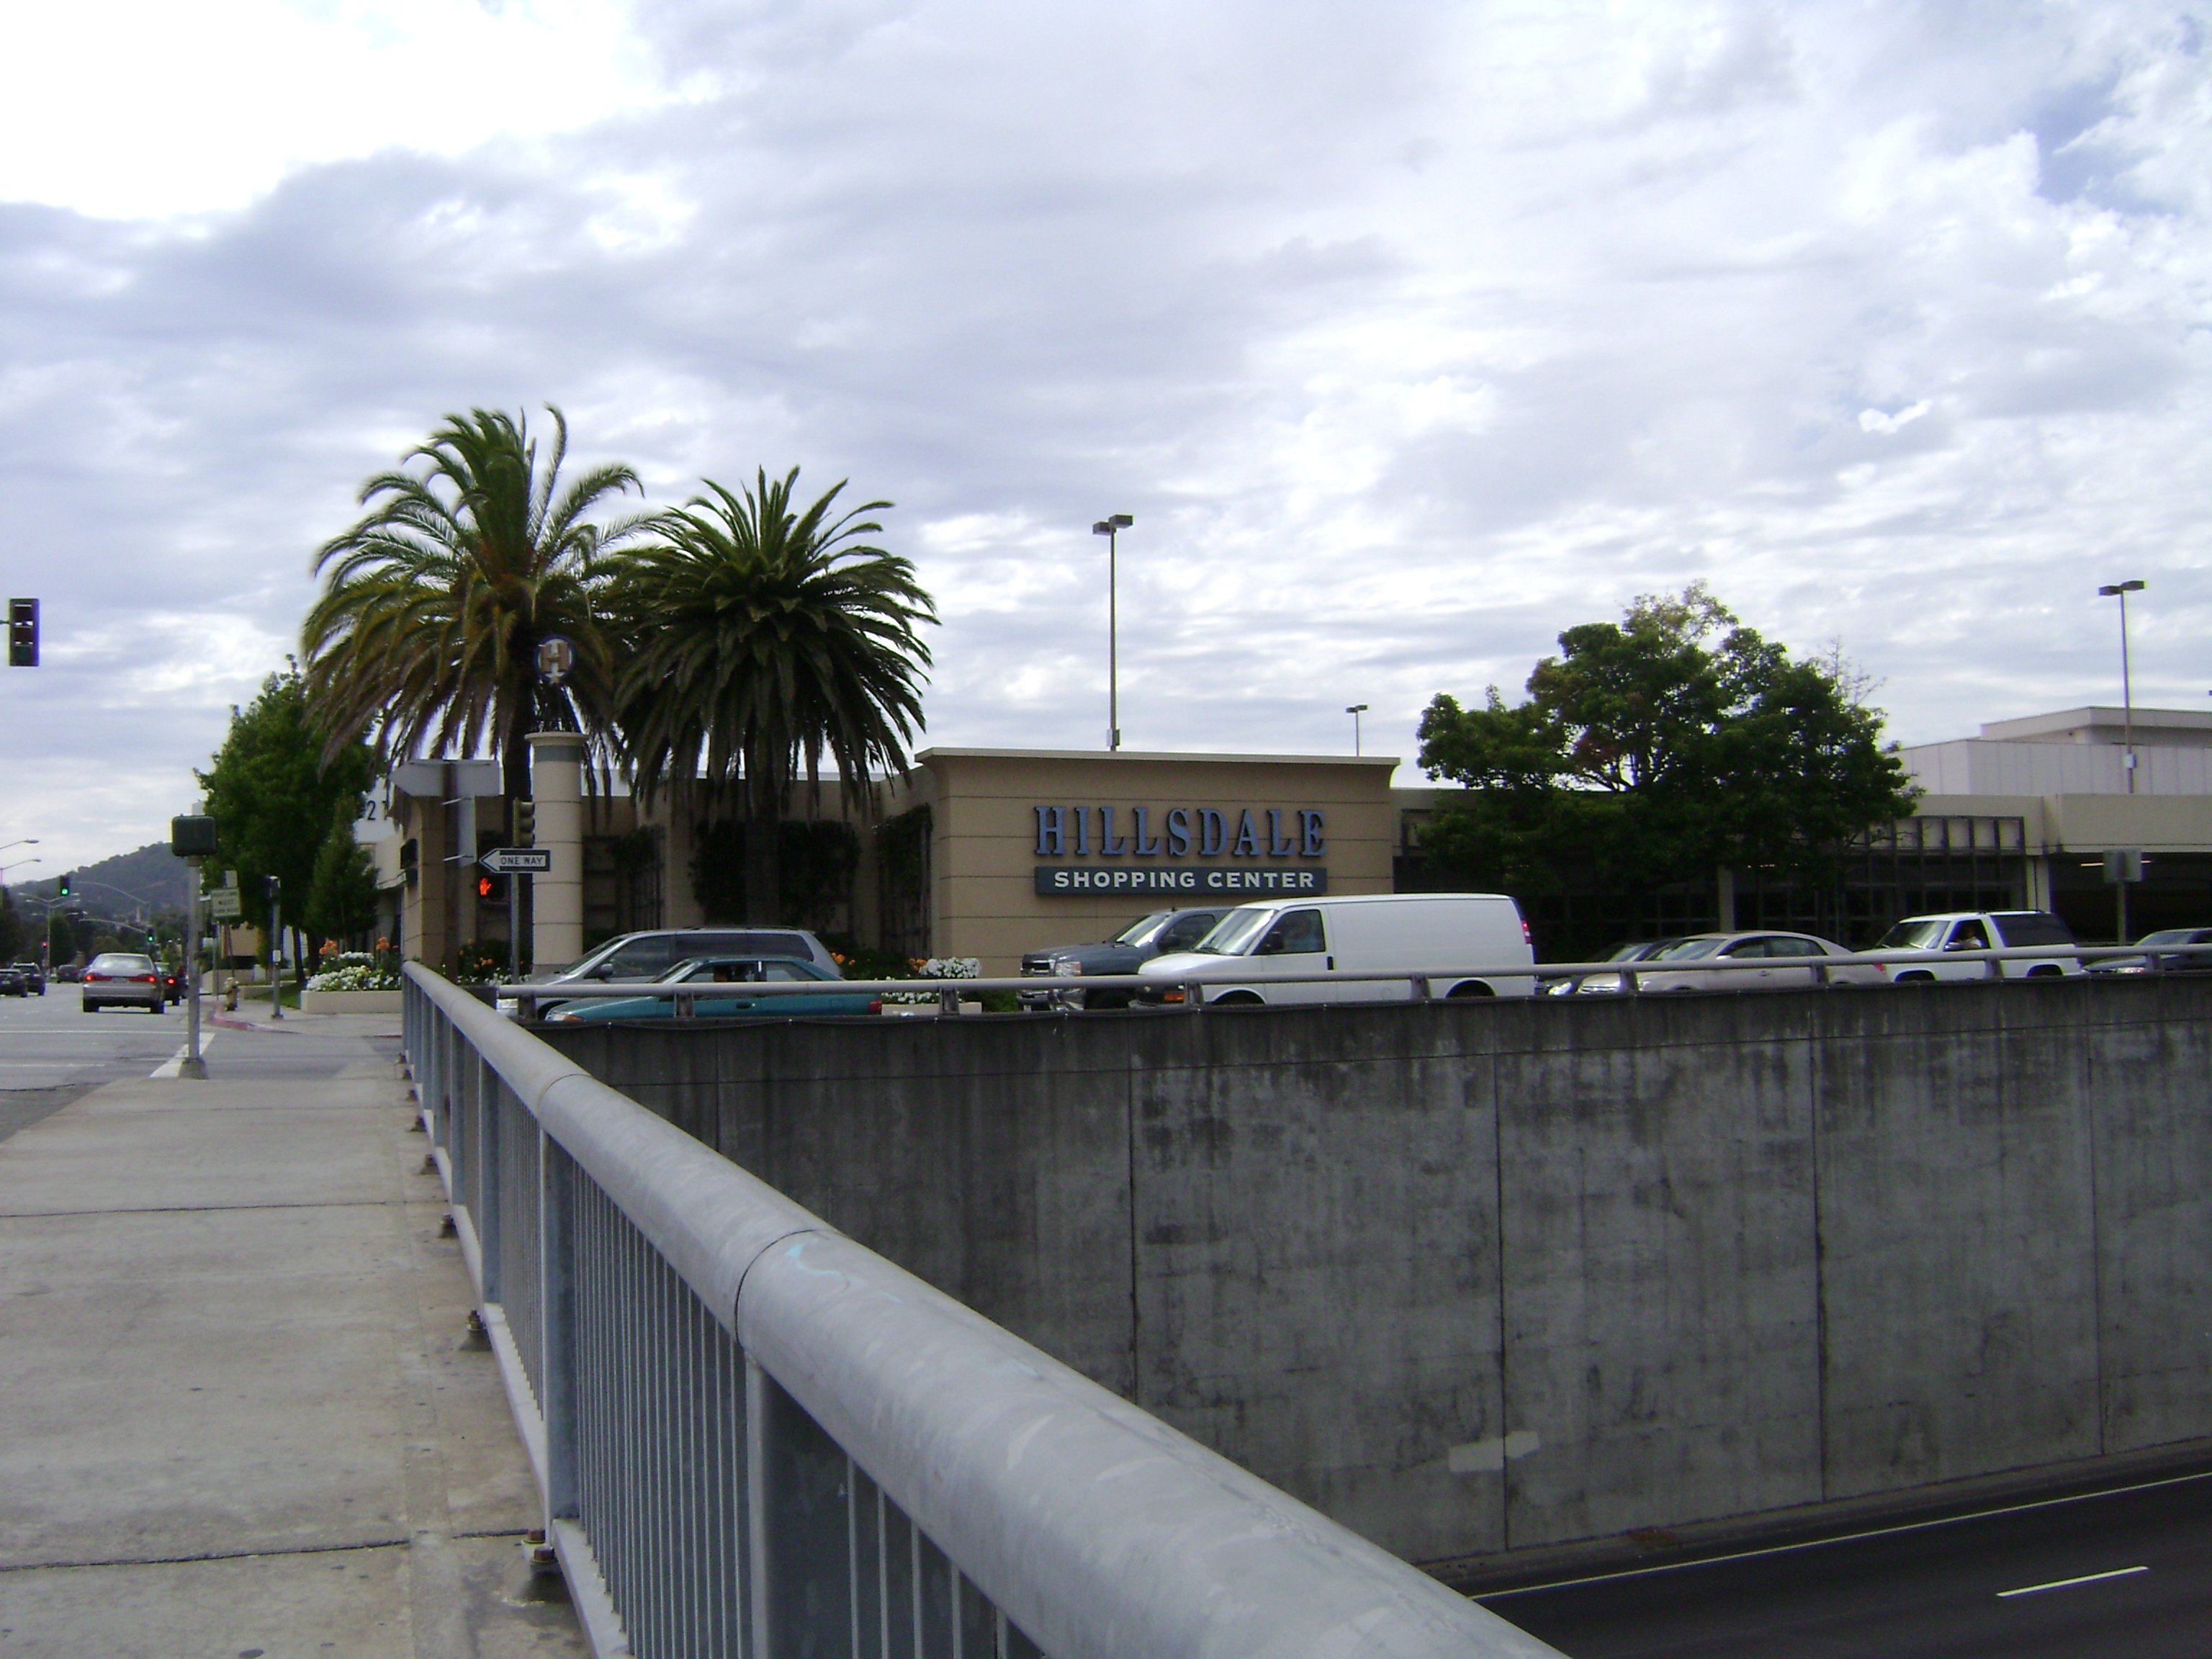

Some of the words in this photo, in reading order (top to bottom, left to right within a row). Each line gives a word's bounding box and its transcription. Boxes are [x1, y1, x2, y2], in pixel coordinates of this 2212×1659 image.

[539, 639, 569, 673] H
[1035, 806, 1326, 858] HILLSDALE
[500, 856, 520, 865] ONE
[523, 856, 543, 865] WAY
[1053, 871, 1196, 889] SHOPPING
[1207, 871, 1314, 889] CENTER
